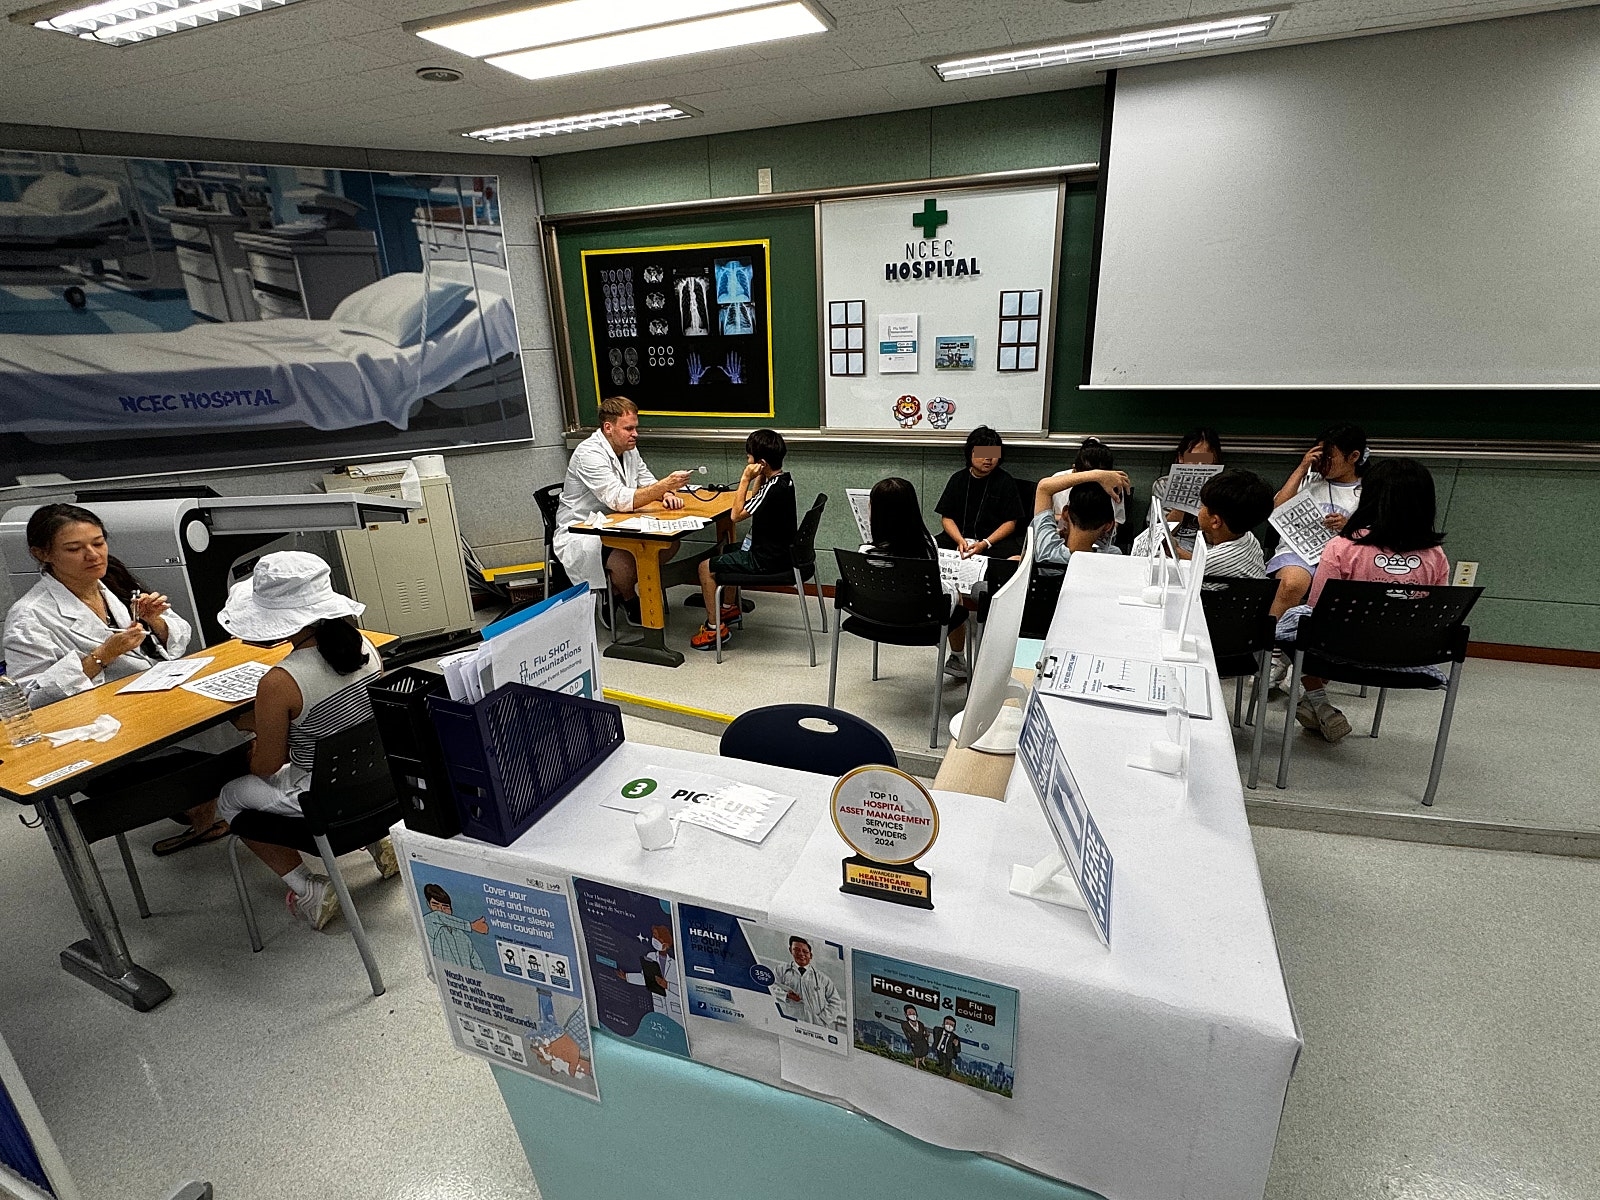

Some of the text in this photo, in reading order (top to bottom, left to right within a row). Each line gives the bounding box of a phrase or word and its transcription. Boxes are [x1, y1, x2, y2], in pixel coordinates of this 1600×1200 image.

[906, 240, 952, 260] NCEC
[885, 258, 980, 280] HOSPITAL
[119, 388, 280, 412] NCEC HOSPITAL
[534, 640, 570, 667] Flu SHOT
[528, 646, 582, 682] Immunizations
[1024, 701, 1046, 772] HAND
[628, 782, 648, 795] 3
[870, 790, 898, 802] TOP 10
[864, 800, 905, 812] HOSPITAL
[840, 806, 930, 826] ASSET MANAGEMENT
[866, 818, 904, 830] SERVICES
[862, 826, 907, 840] PROVIDERS
[874, 838, 894, 846] 2024
[1083, 823, 1100, 902] HERE
[858, 872, 911, 888] HEALTHCARE
[870, 870, 894, 878] AWARDED
[483, 883, 528, 901] Cover your
[850, 876, 922, 896] BUSINESS REVIEW
[486, 896, 550, 918] nose and mouth
[614, 907, 636, 918] Services
[488, 908, 555, 929] with your sleeve
[688, 920, 715, 930] YOUR
[490, 918, 554, 940] when coughing!
[689, 928, 728, 942] HEALTH
[692, 944, 734, 958] PRIORITY
[701, 938, 720, 948] OUR
[444, 968, 482, 987] Wash your
[755, 970, 772, 979] 35%
[446, 979, 506, 1002] hands with soap
[872, 976, 954, 1010] Fine dust &
[450, 988, 514, 1014] and running water
[968, 1002, 982, 1010] Flu
[452, 996, 462, 1006] for
[464, 1001, 472, 1010] at
[473, 1002, 492, 1016] least
[492, 1010, 502, 1020] 30
[504, 1014, 538, 1030] seconds!
[958, 1008, 994, 1022] covid 19
